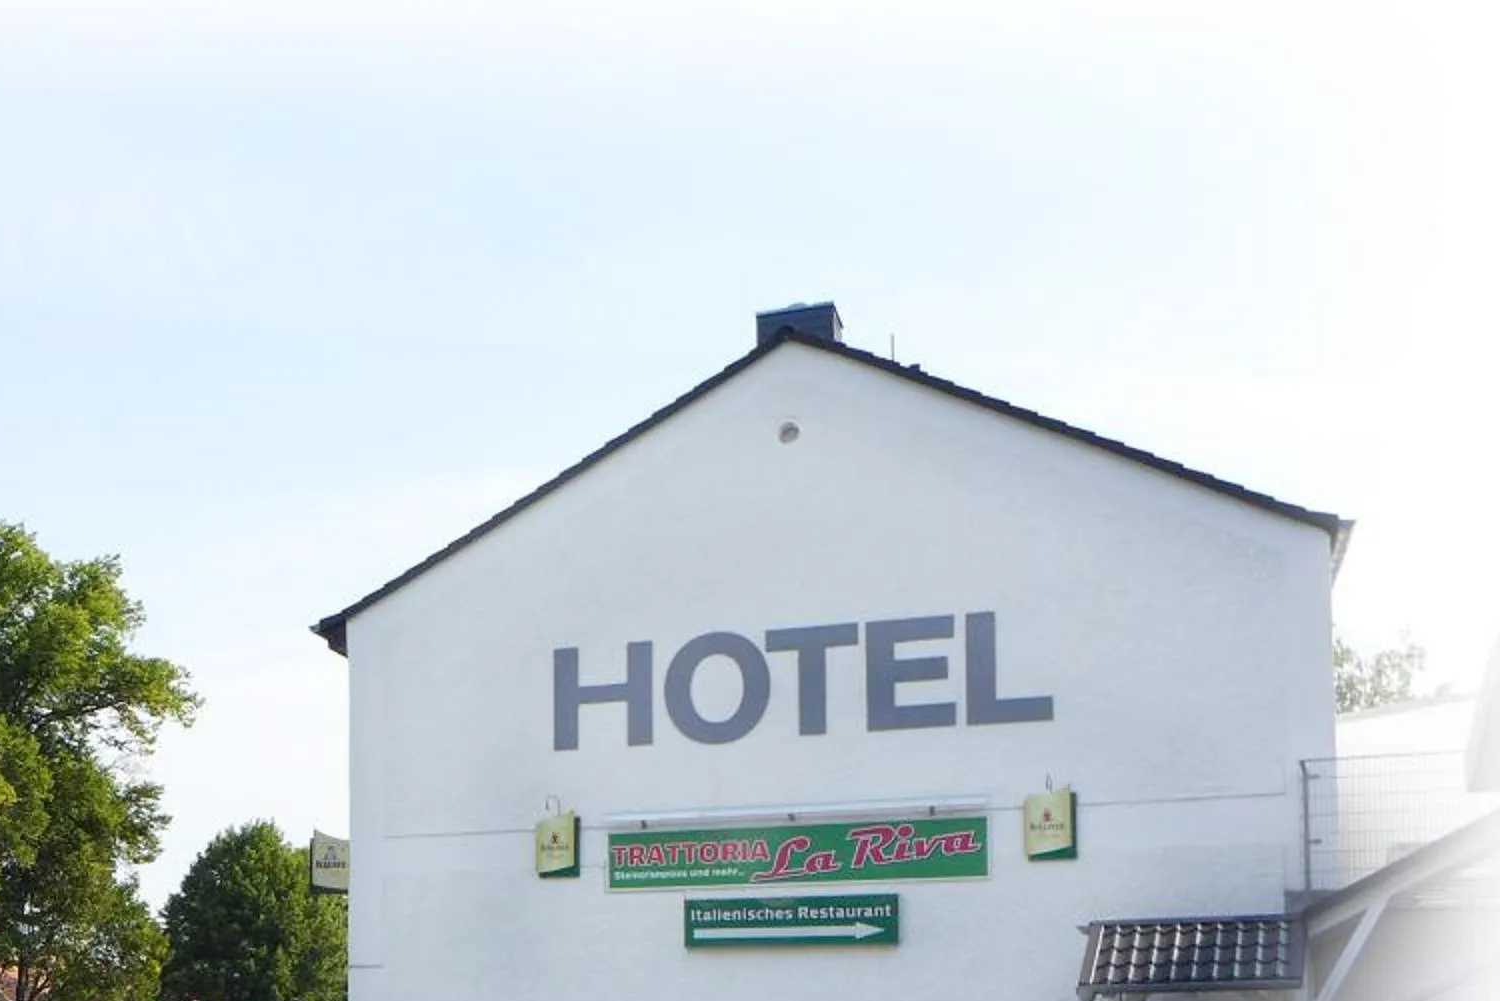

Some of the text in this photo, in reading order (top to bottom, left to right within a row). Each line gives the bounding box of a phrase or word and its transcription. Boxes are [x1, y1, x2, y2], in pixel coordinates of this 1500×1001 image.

[553, 611, 1054, 751] HOTEL
[612, 823, 982, 882] TRATTORIA La Riva
[690, 904, 892, 922] Italienisches Restaurant
